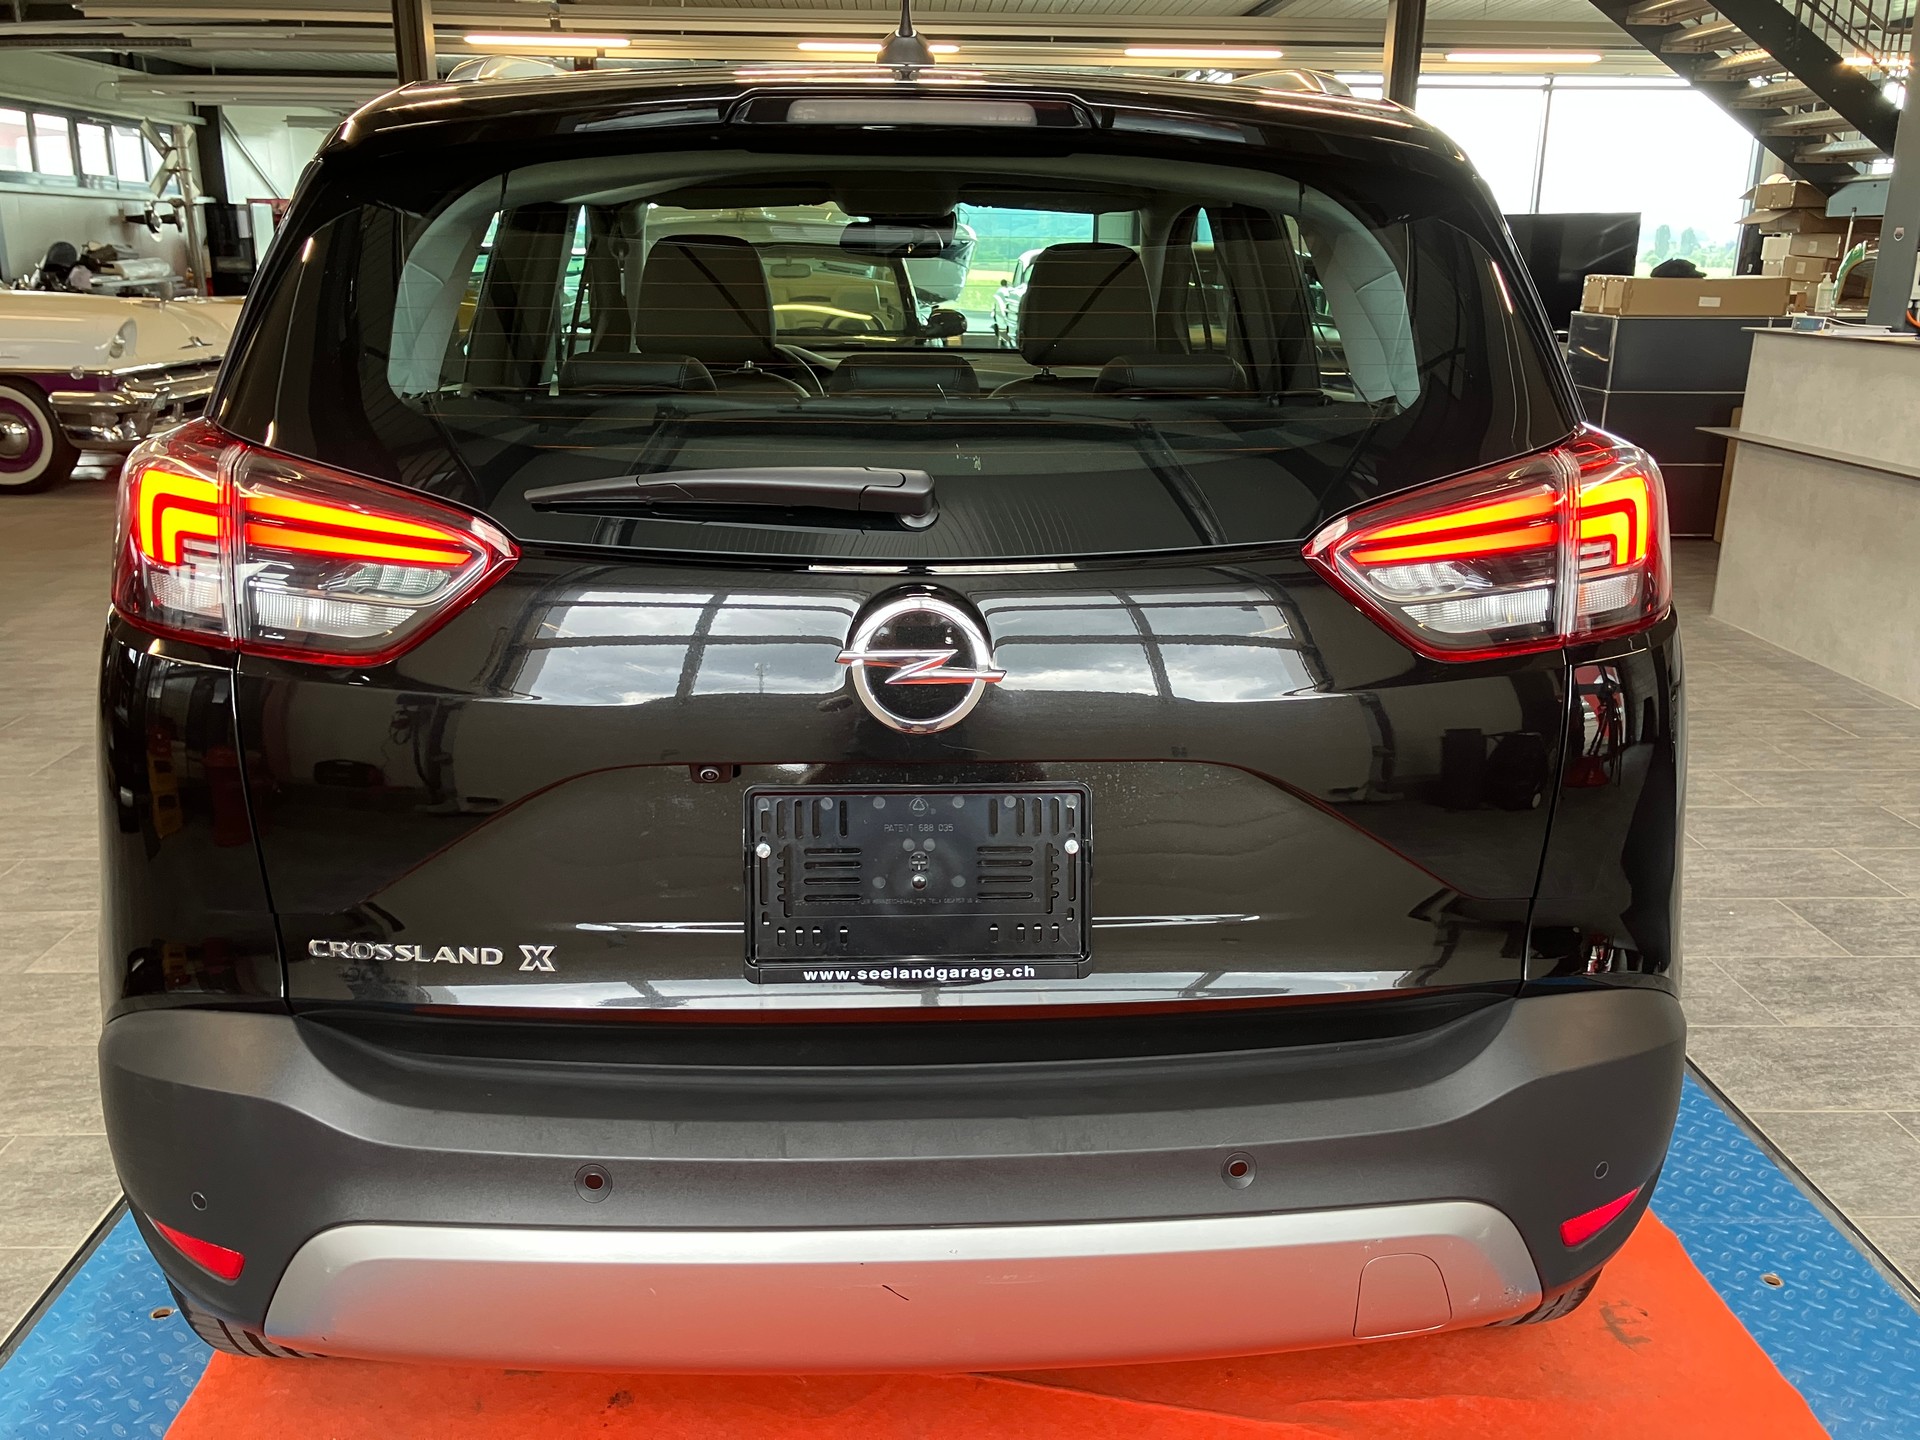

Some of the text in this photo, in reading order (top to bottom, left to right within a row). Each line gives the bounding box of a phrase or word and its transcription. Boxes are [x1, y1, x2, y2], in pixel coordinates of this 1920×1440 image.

[308, 939, 557, 972] CROSSLAND X
[803, 965, 1036, 981] www.seelandgarage.ch
